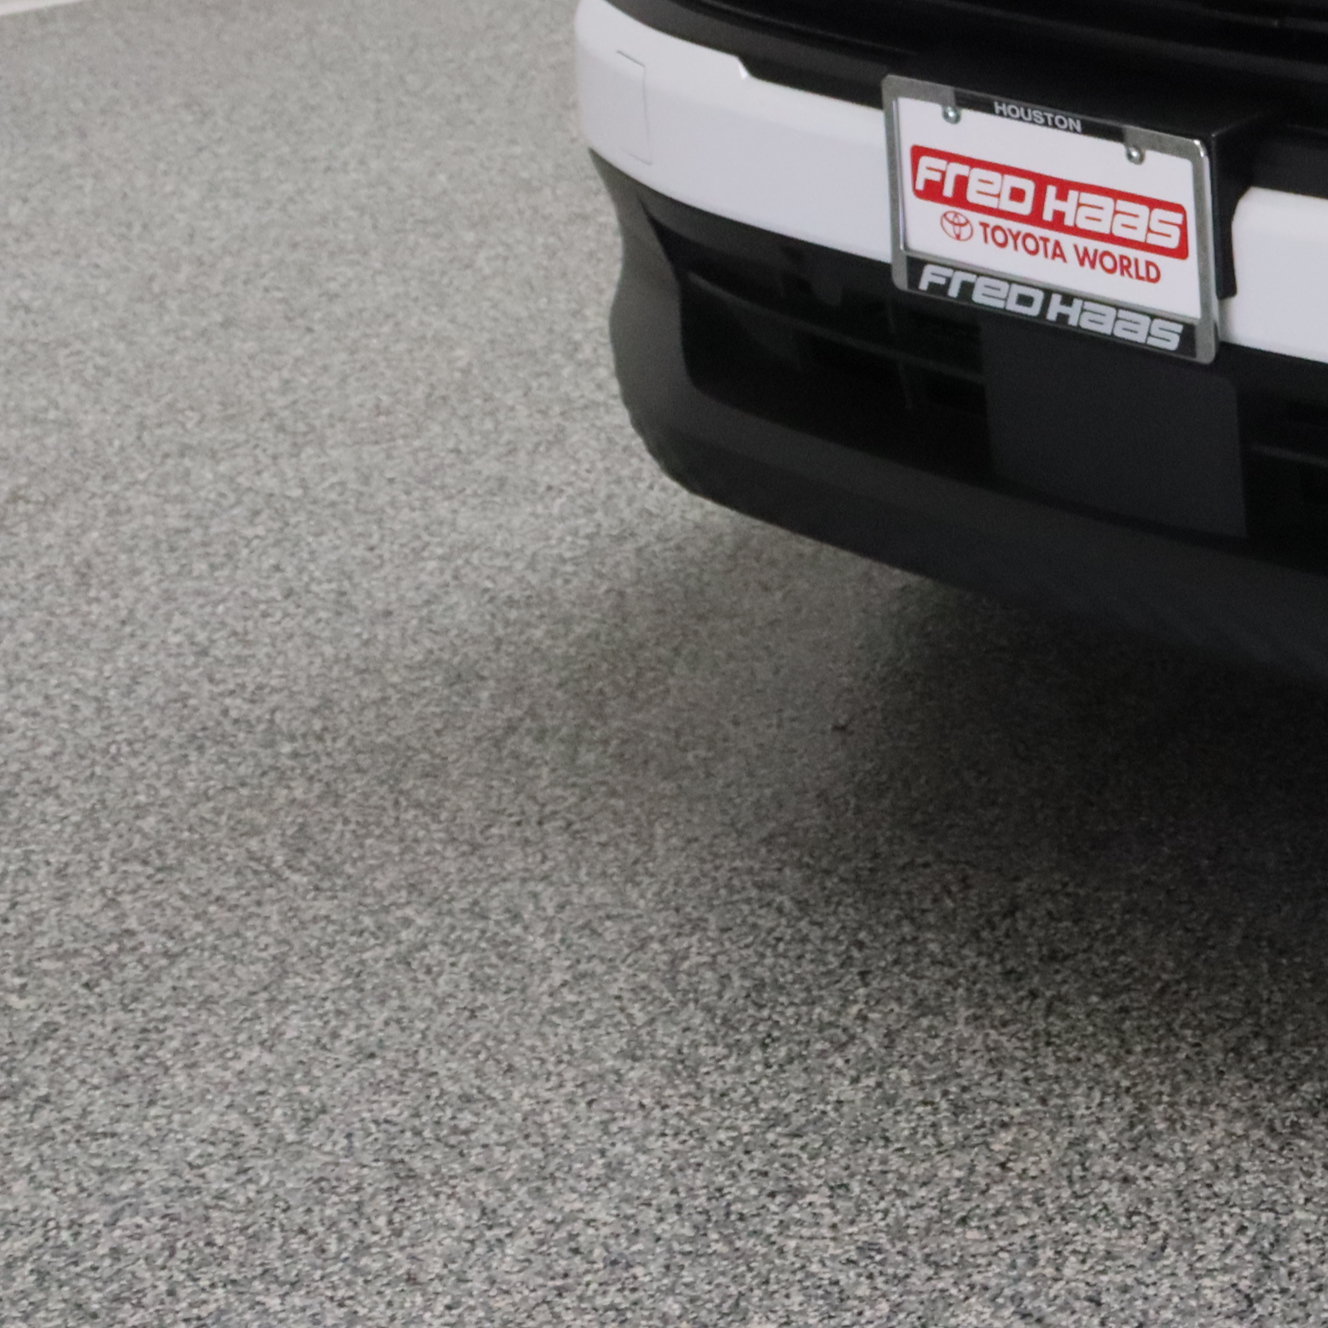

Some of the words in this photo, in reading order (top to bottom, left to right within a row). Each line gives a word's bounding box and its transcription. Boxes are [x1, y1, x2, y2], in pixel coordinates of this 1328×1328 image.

[993, 101, 1082, 133] HOUSTON
[979, 221, 1068, 263] TOYOTA
[1073, 244, 1162, 284] WORLD
